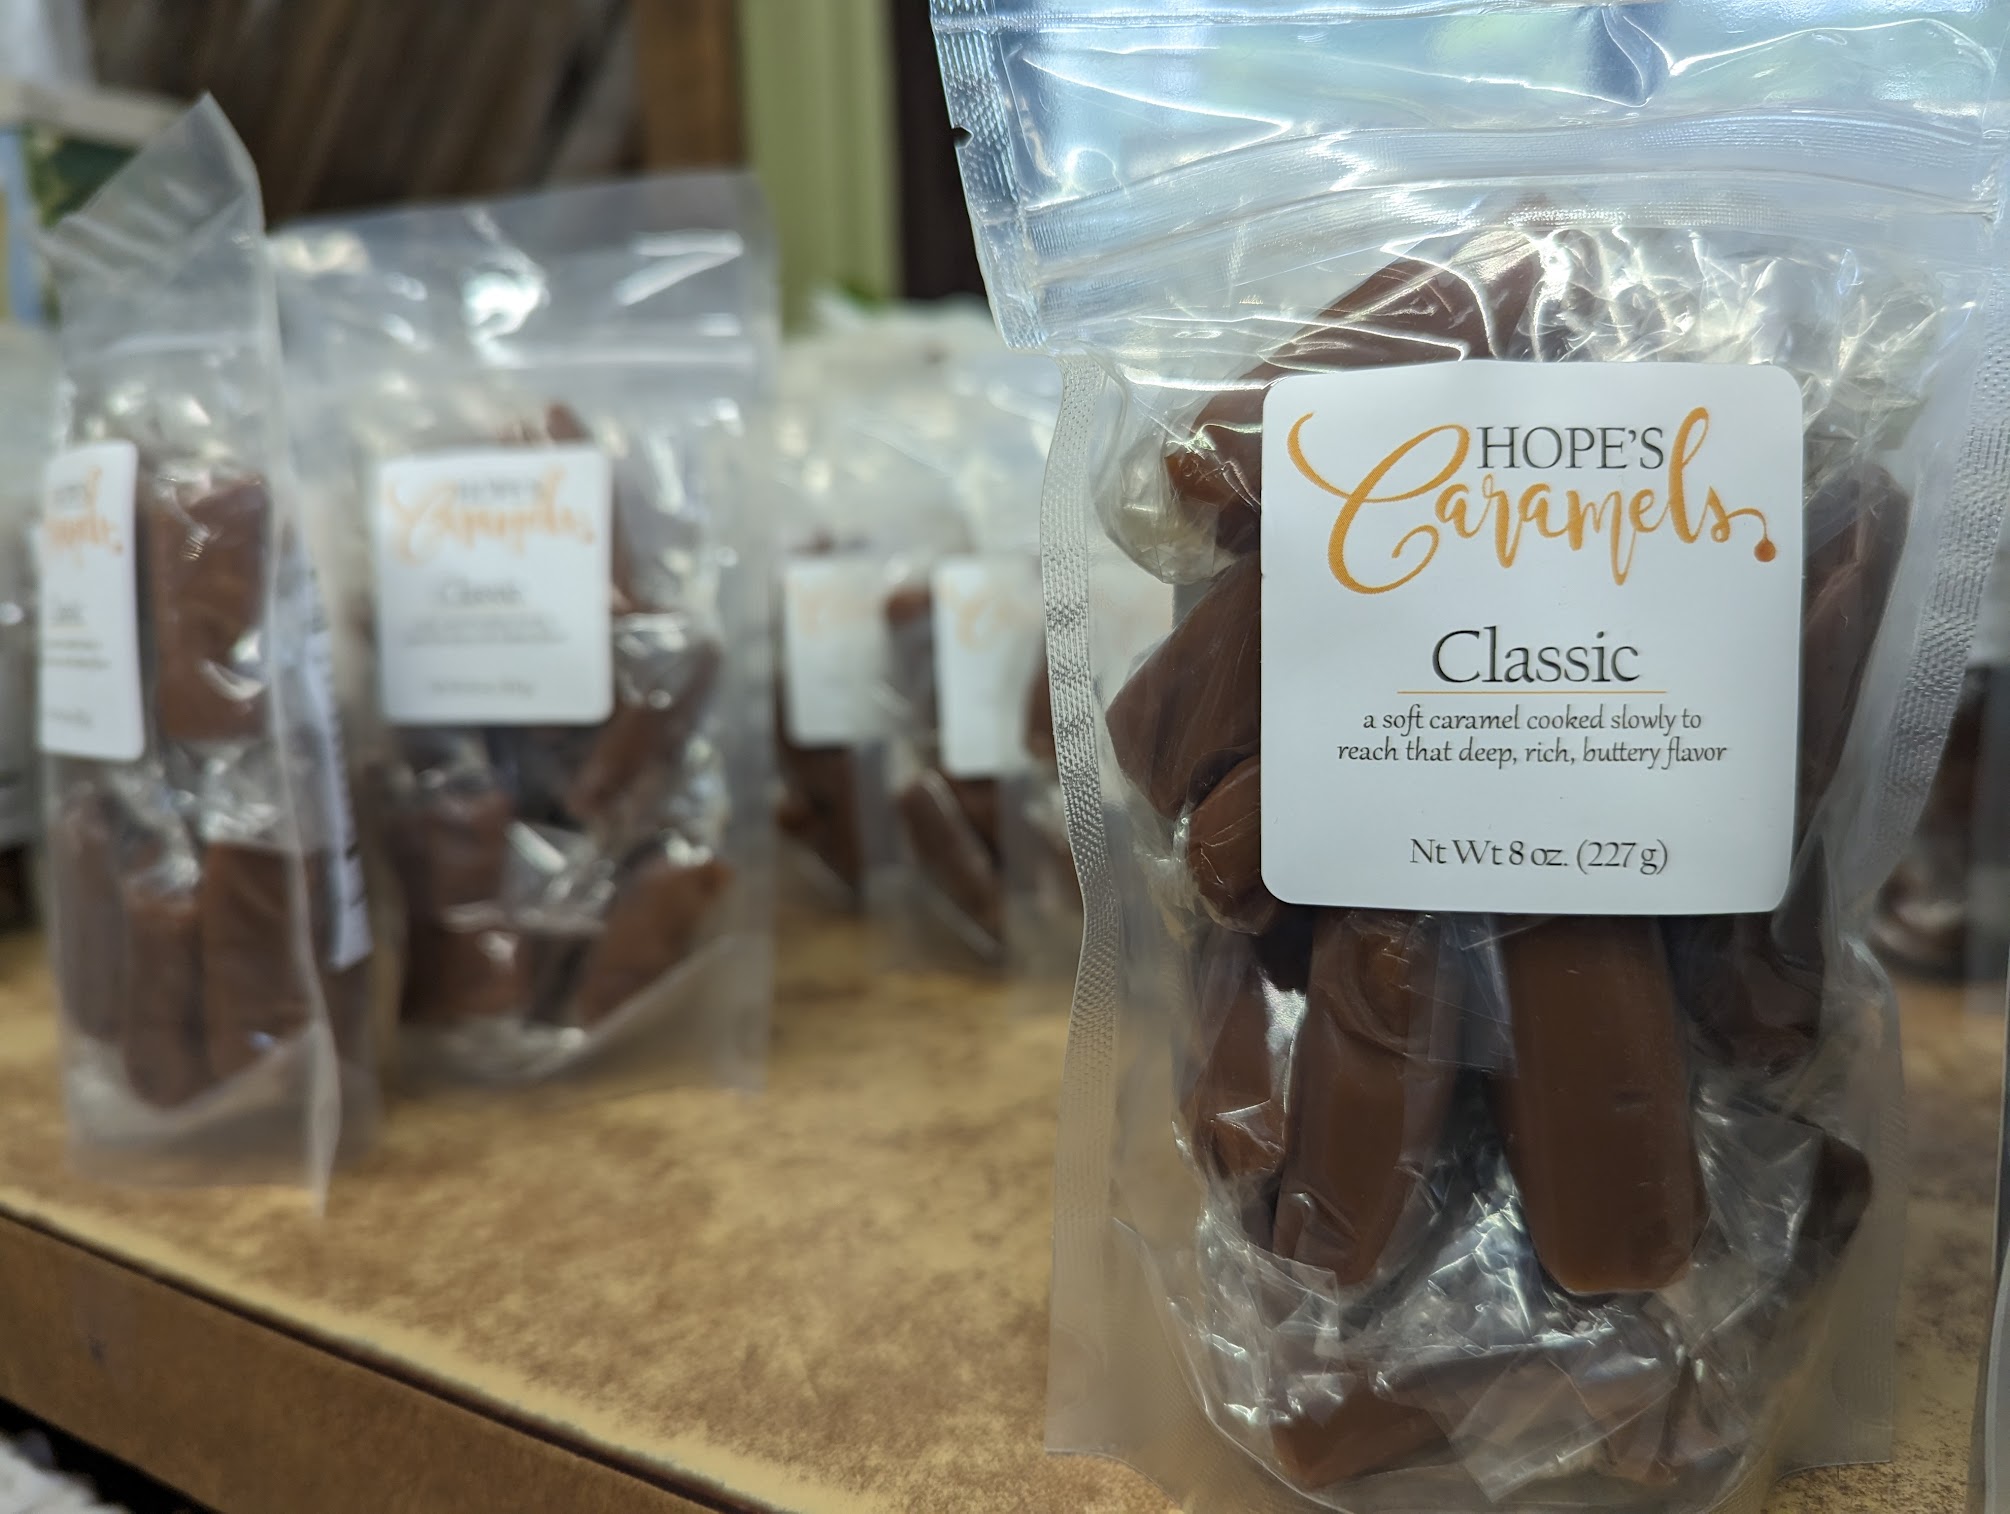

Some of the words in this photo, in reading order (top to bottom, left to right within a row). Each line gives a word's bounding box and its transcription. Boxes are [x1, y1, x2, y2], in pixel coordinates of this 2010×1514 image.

[1477, 427, 1664, 469] HOPE'S
[1288, 407, 1776, 594] Caramels
[1432, 625, 1640, 683] Classic
[1363, 715, 1377, 728] a
[1383, 704, 1424, 739] soft
[1430, 704, 1520, 729] caramel
[1527, 704, 1605, 729] cooked
[1611, 704, 1678, 739] slowly
[1682, 708, 1701, 728] to
[1337, 736, 1399, 760] reach
[1404, 736, 1452, 761] that
[1459, 736, 1517, 769] deep,
[1525, 737, 1575, 765] rich,
[1583, 736, 1662, 769] buttery
[1660, 736, 1727, 770] flavor
[1410, 839, 1447, 864] Nt
[1457, 840, 1503, 865] Wt
[1509, 841, 1524, 865] 8
[1531, 848, 1568, 866] oz.
